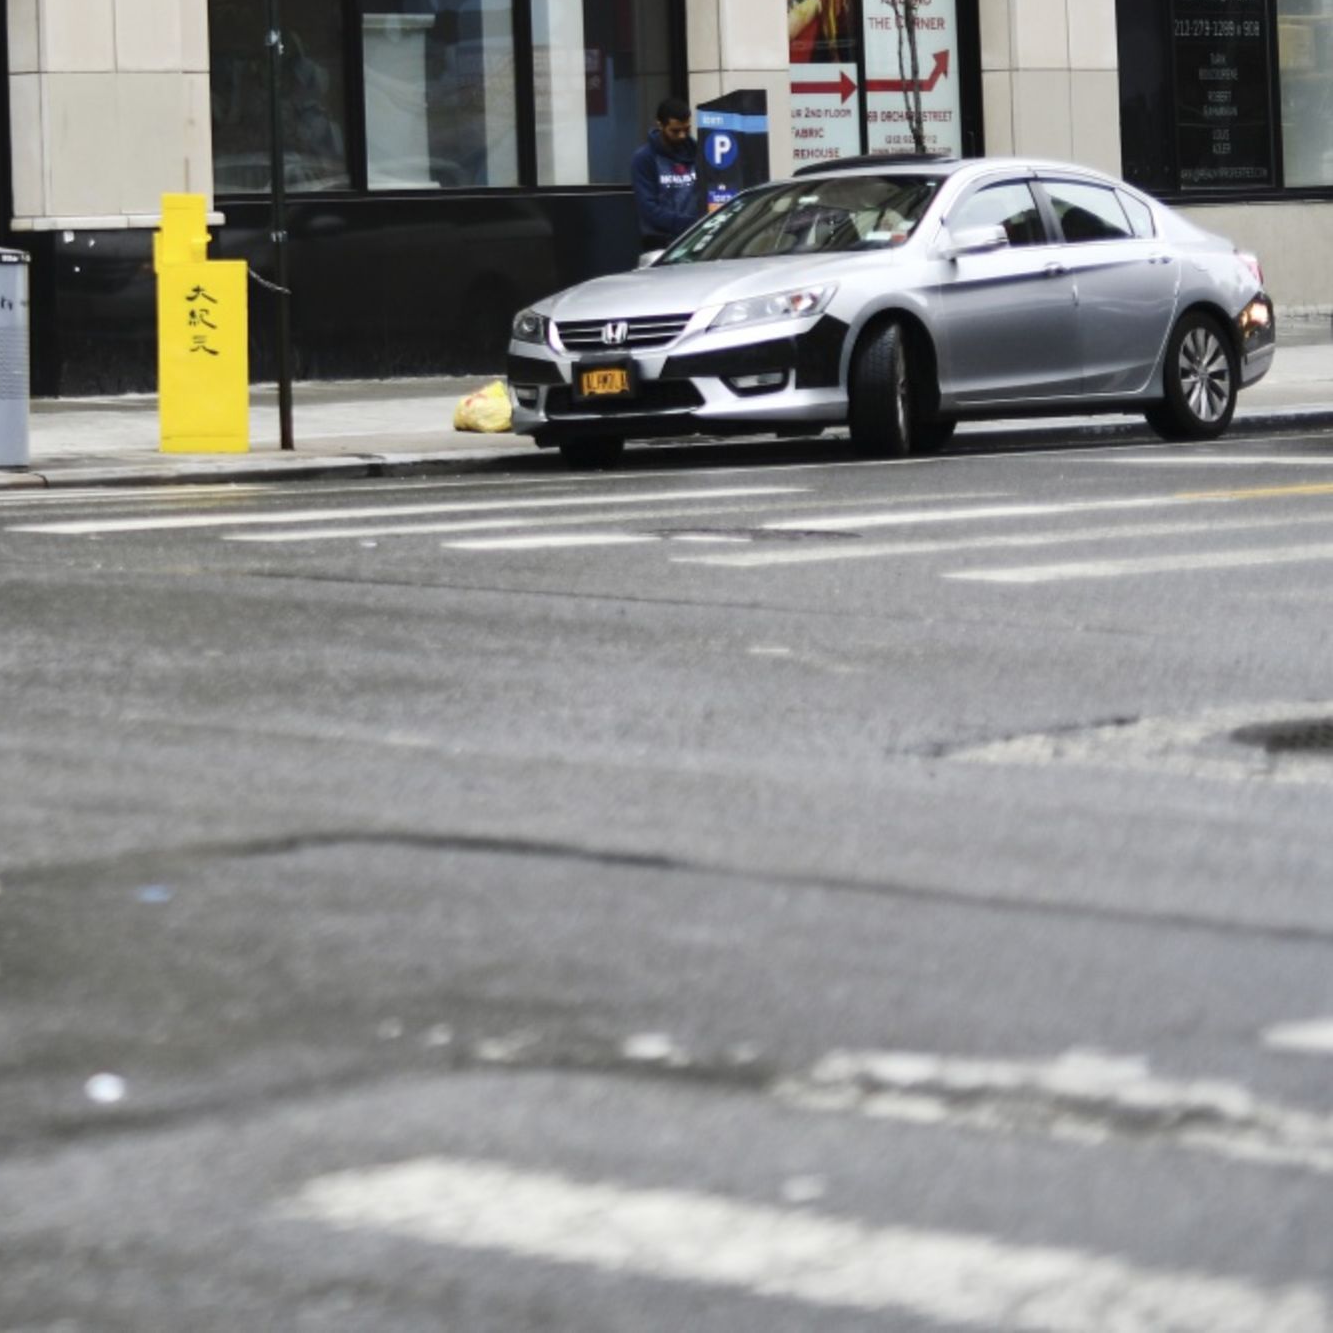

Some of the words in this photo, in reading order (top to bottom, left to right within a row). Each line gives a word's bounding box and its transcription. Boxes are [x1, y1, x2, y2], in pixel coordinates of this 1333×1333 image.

[868, 16, 892, 30] THE
[896, 16, 946, 31] CRNER
[714, 134, 732, 164] P
[186, 285, 219, 355] 大紀元
